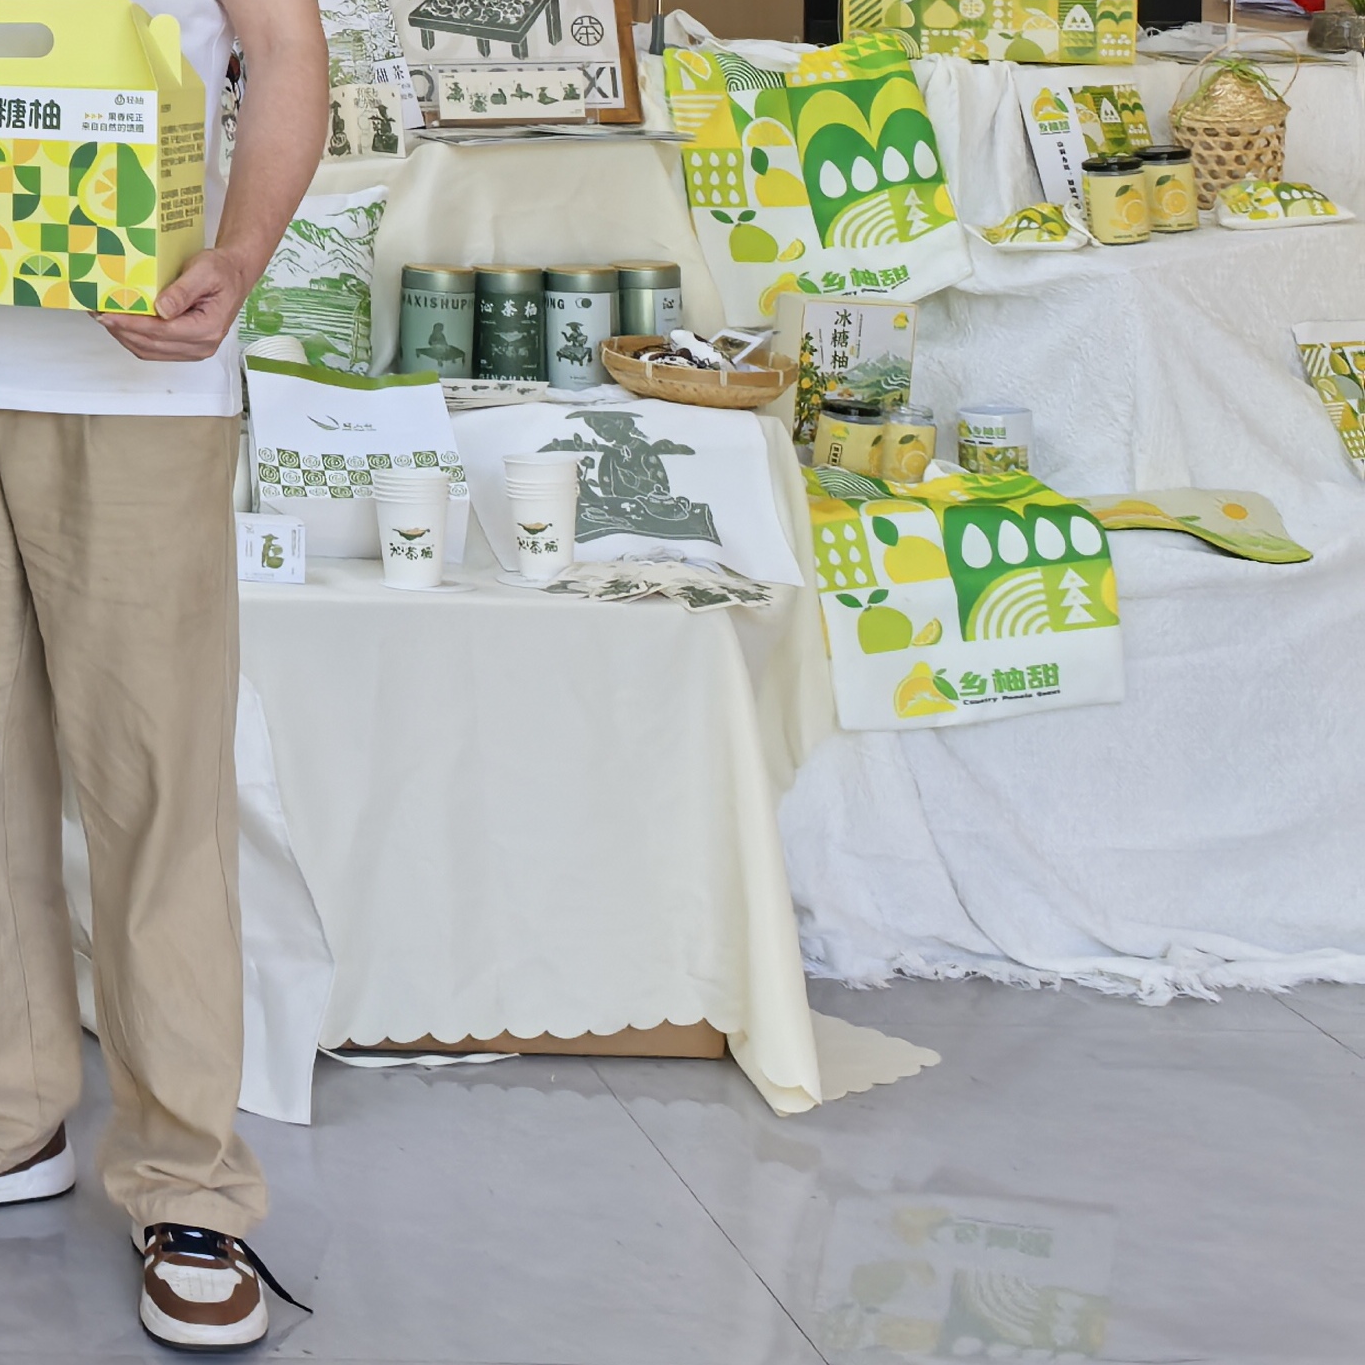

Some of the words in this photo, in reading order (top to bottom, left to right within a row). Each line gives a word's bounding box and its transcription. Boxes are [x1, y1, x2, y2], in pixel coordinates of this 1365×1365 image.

[108, 112, 144, 122] 果香纯正
[821, 265, 911, 293] 乡柚甜
[830, 309, 852, 370] 冰糖柚
[959, 662, 1059, 697] 乡柚甜
